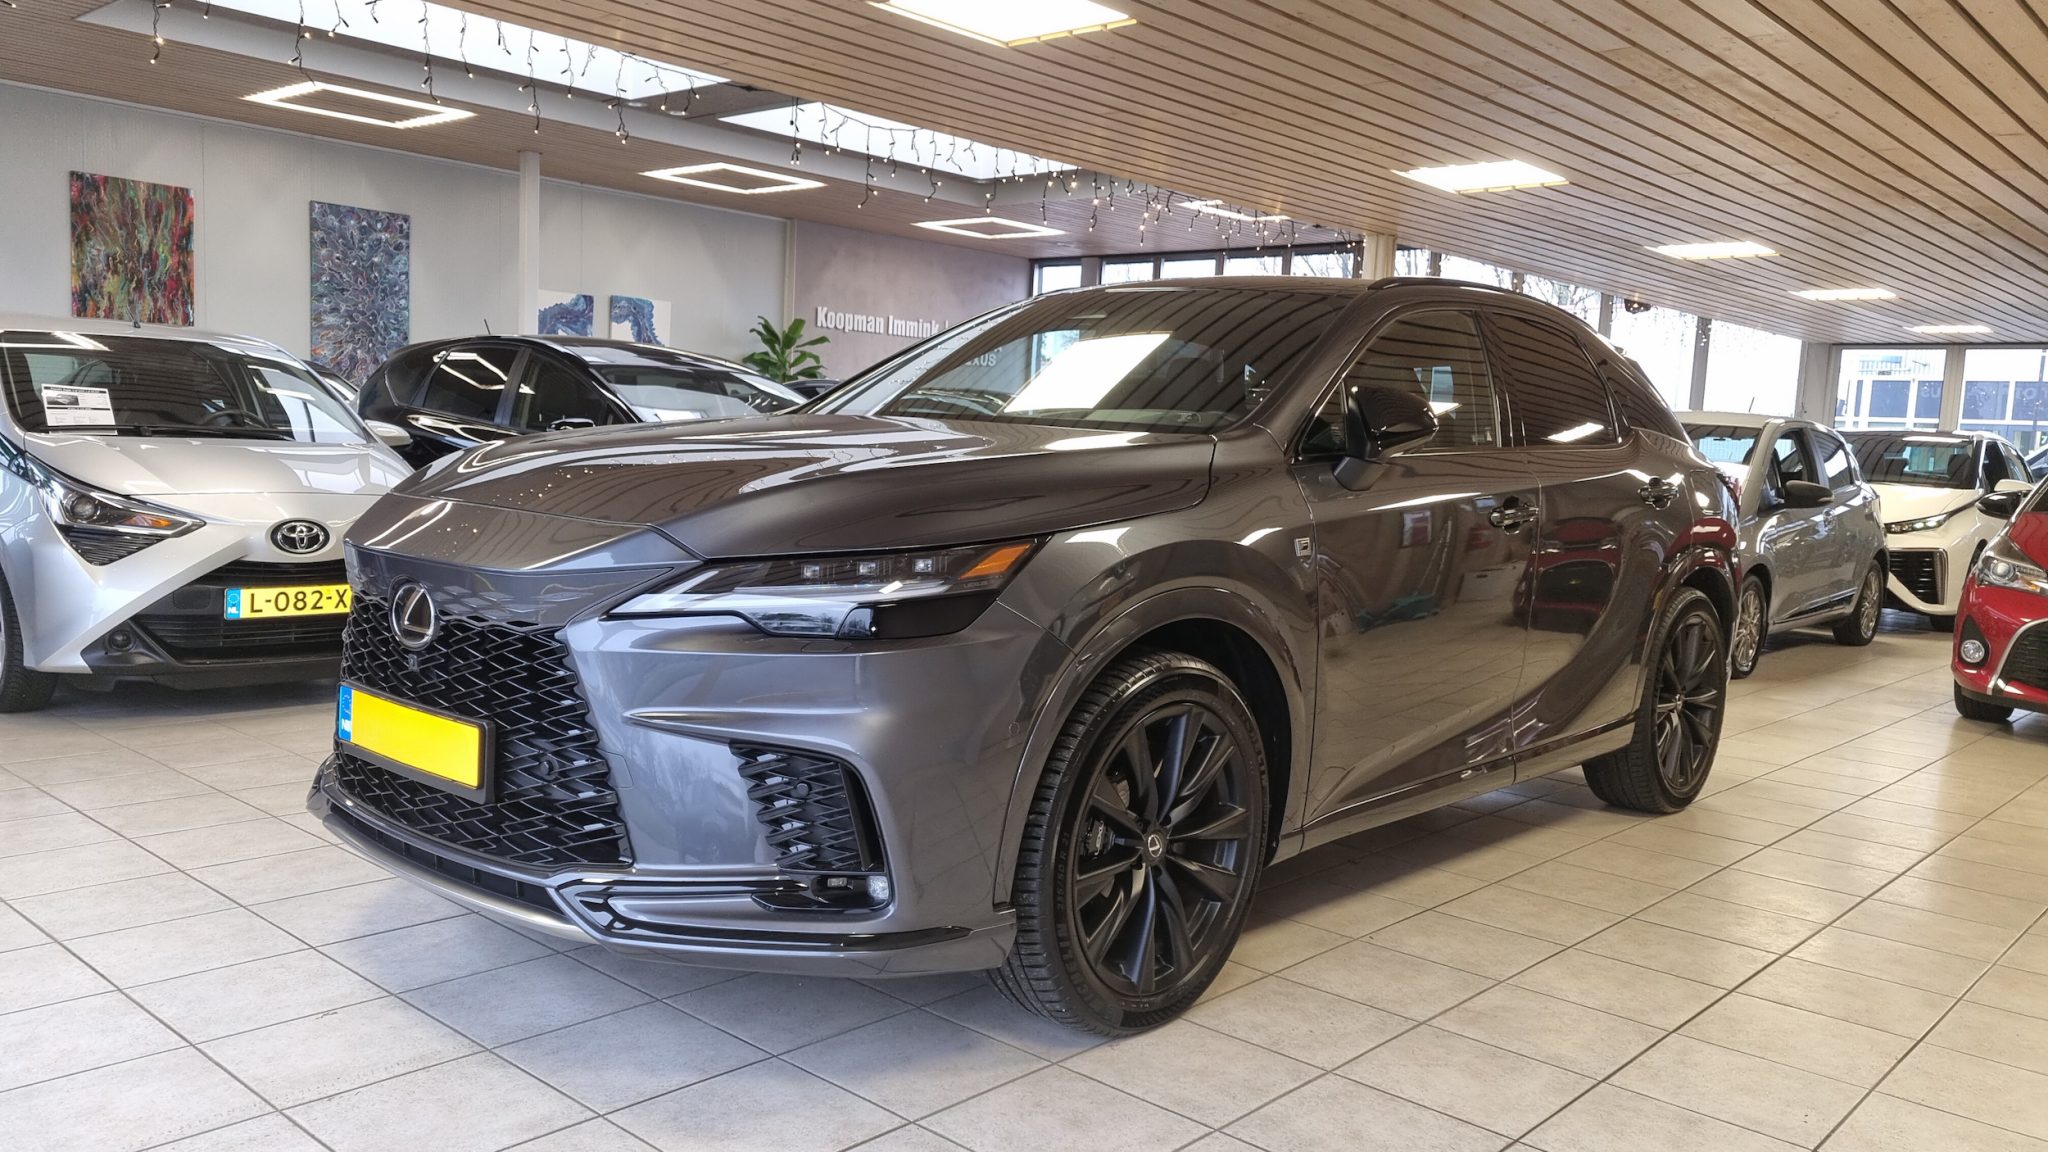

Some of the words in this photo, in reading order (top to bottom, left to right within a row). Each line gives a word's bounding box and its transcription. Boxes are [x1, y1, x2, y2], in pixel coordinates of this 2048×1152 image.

[816, 306, 884, 333] Koopman
[887, 315, 939, 338] Immink
[227, 606, 239, 614] NL
[250, 589, 348, 613] L-082-X
